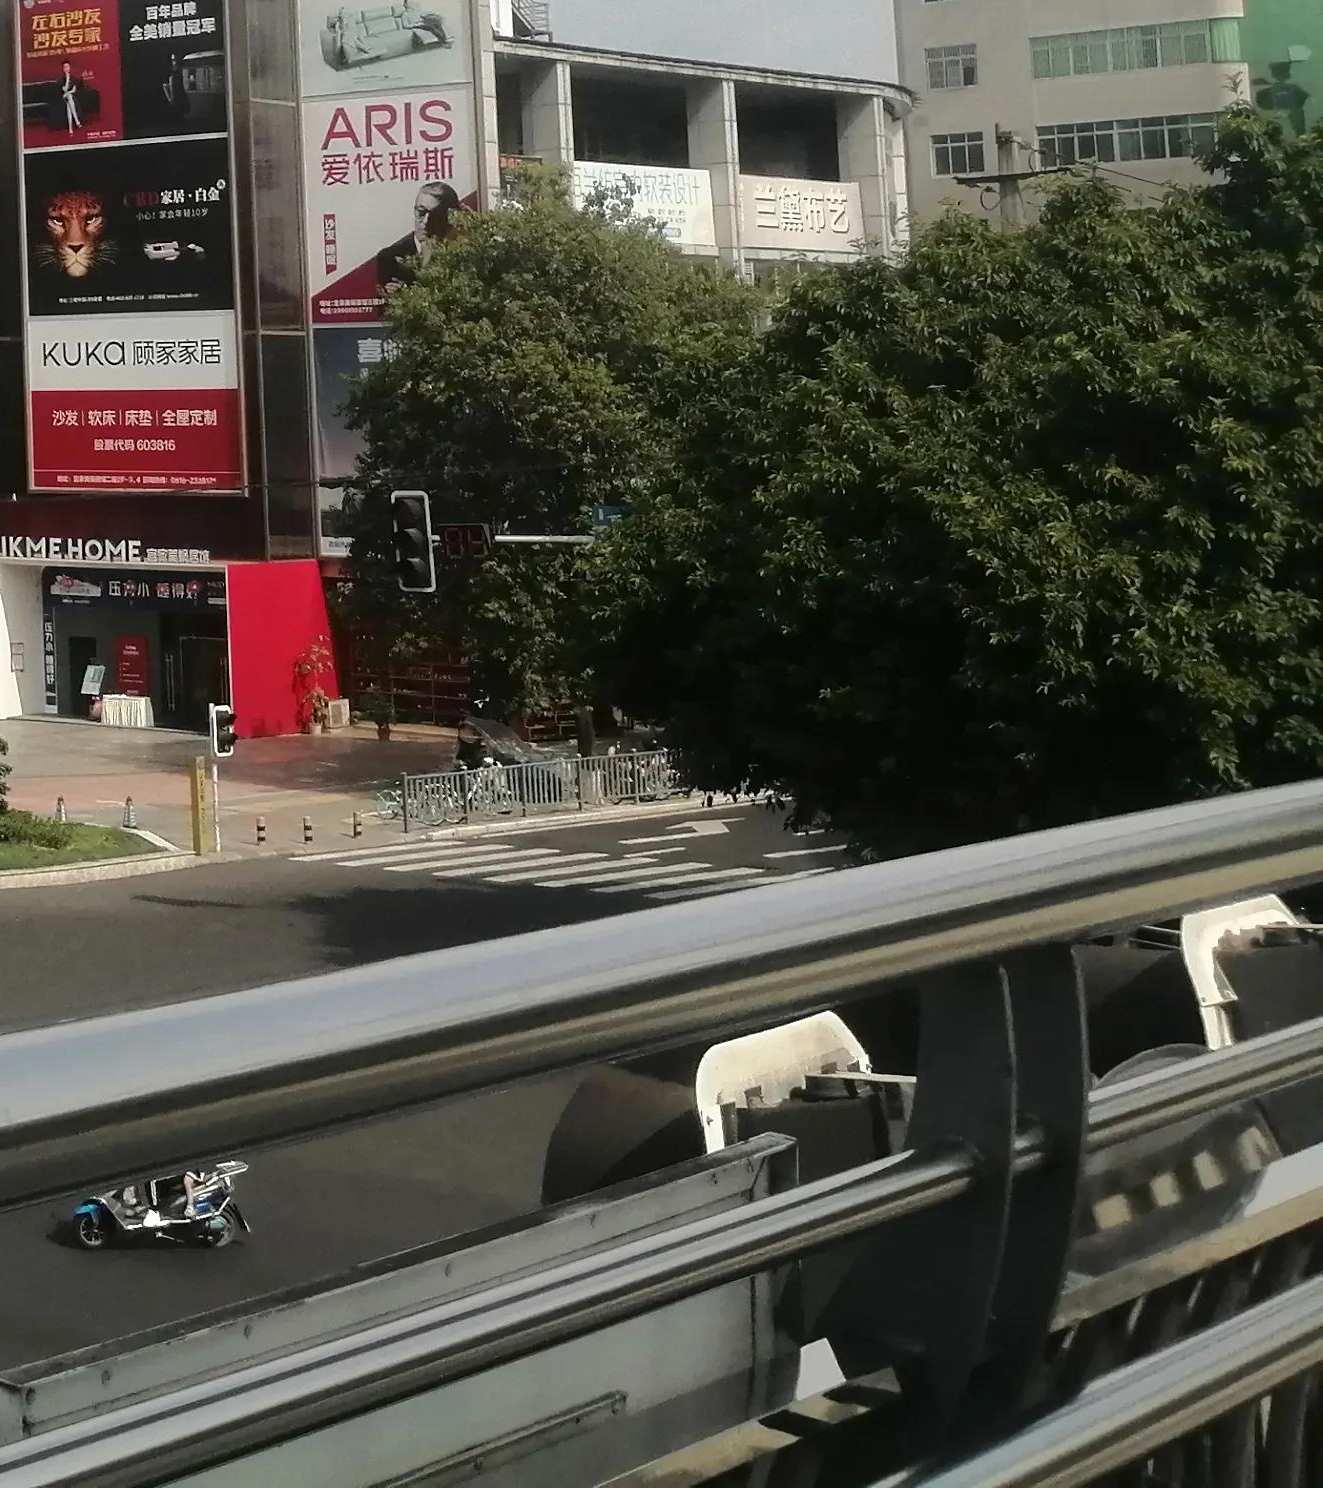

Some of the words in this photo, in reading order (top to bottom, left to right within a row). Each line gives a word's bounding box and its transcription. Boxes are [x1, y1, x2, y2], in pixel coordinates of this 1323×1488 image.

[31, 8, 101, 31] 左右沙发
[145, 1, 197, 21] 百年品牌
[33, 26, 102, 50] 沙发专家
[129, 17, 216, 42] 全美销量冠军
[321, 100, 453, 150] ARIS
[321, 146, 454, 186] 爱依瑞斯
[132, 339, 222, 366] 顾家家居
[52, 410, 78, 426] 沙发
[88, 410, 116, 426] 软床
[124, 410, 152, 426] 床垫
[161, 409, 217, 427] 全屋定制
[93, 439, 135, 452] 股票代码
[136, 438, 176, 452] 603816
